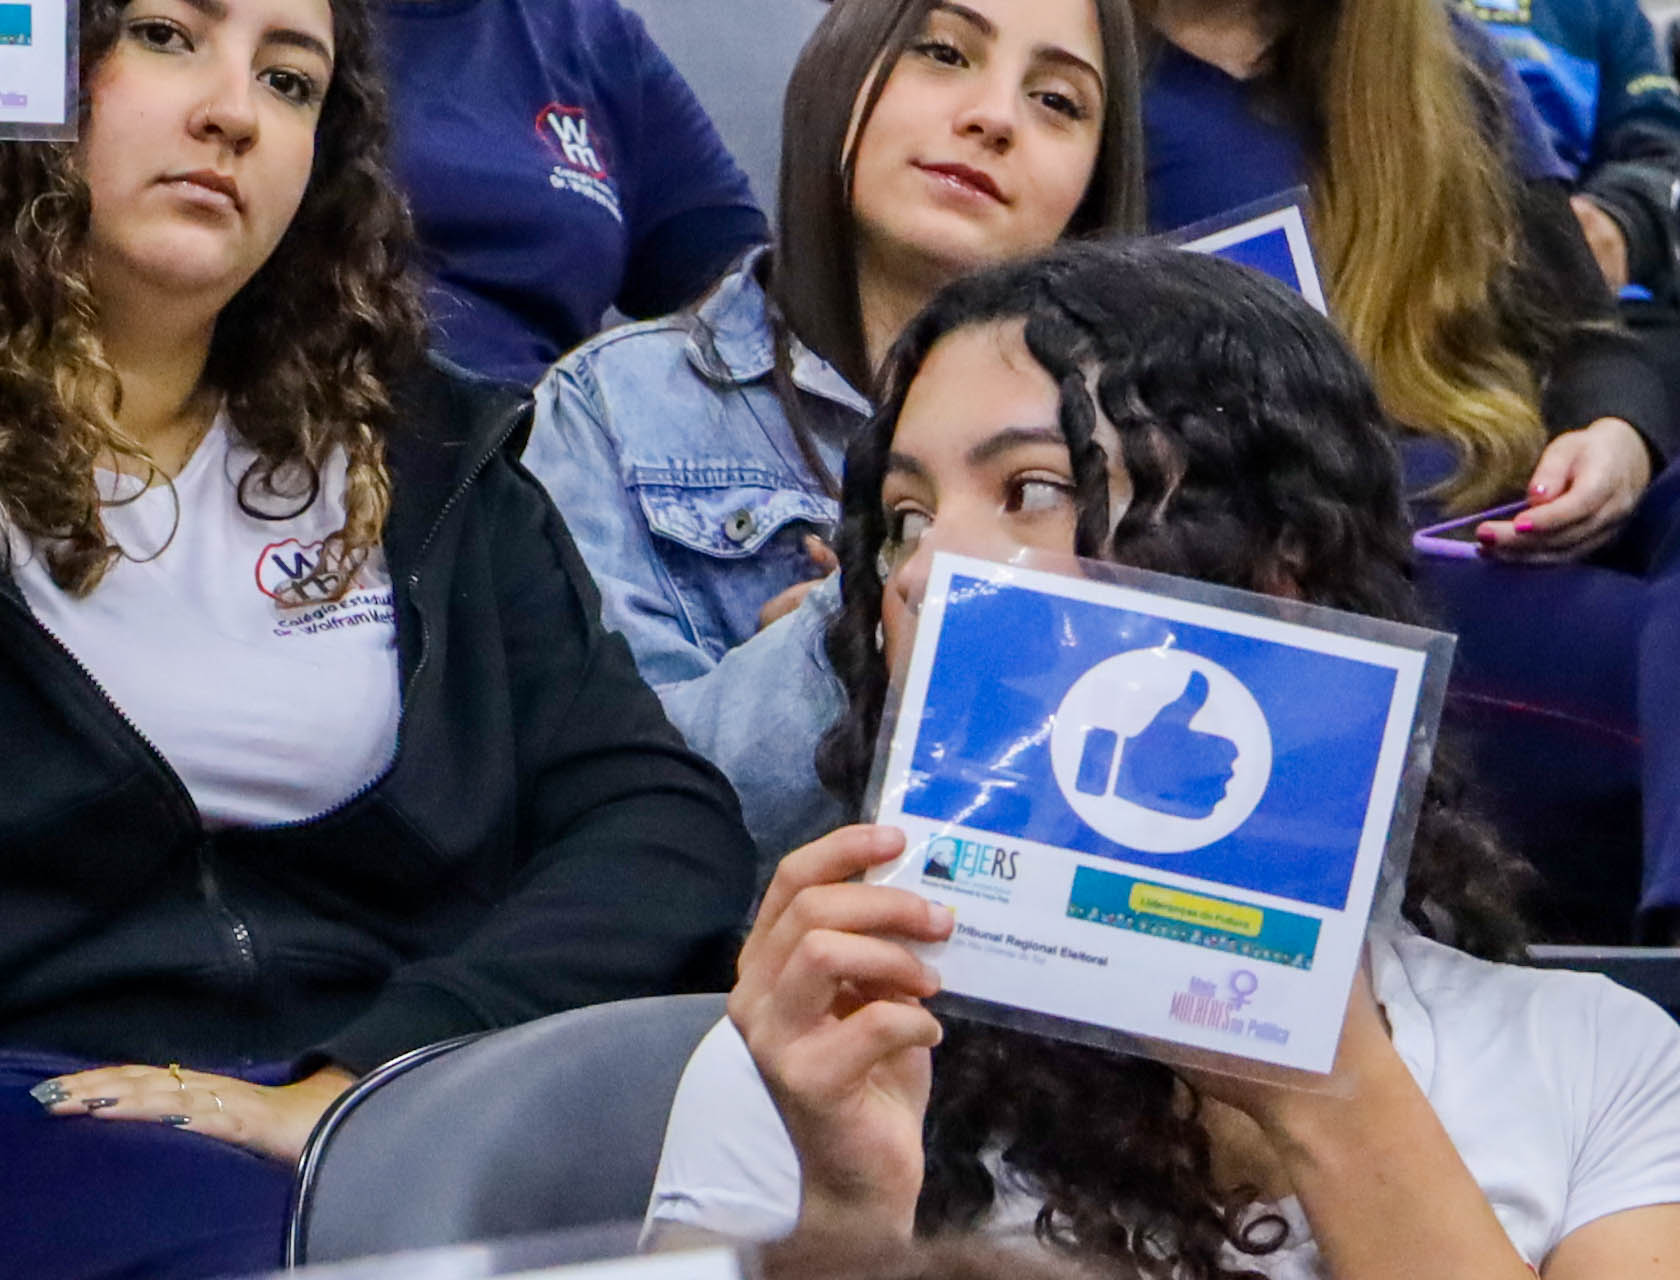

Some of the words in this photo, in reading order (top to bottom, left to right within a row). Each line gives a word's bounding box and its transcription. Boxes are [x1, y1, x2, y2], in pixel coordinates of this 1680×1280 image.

[962, 841, 1020, 882] EJERS
[955, 922, 1004, 943] Tribunal
[1005, 933, 1058, 957] Regional
[1059, 946, 1109, 967] Eleitoral
